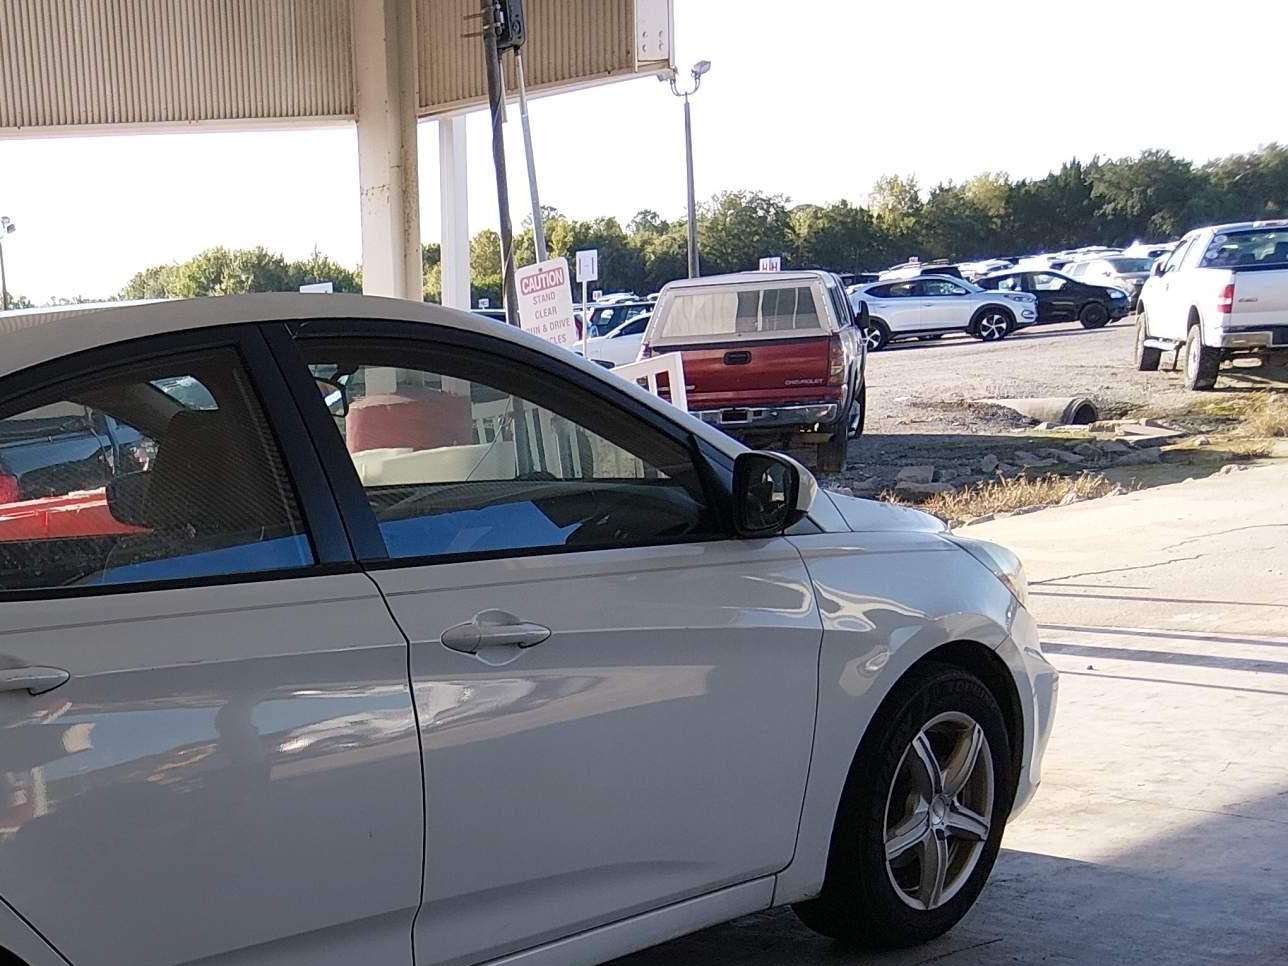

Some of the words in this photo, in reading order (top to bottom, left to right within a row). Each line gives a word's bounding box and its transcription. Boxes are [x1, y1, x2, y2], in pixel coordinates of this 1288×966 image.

[521, 268, 563, 293] CAUTION
[533, 291, 555, 305] STAND
[535, 306, 558, 319] CLEAR
[542, 323, 548, 333] &
[550, 317, 570, 331] DRIVE
